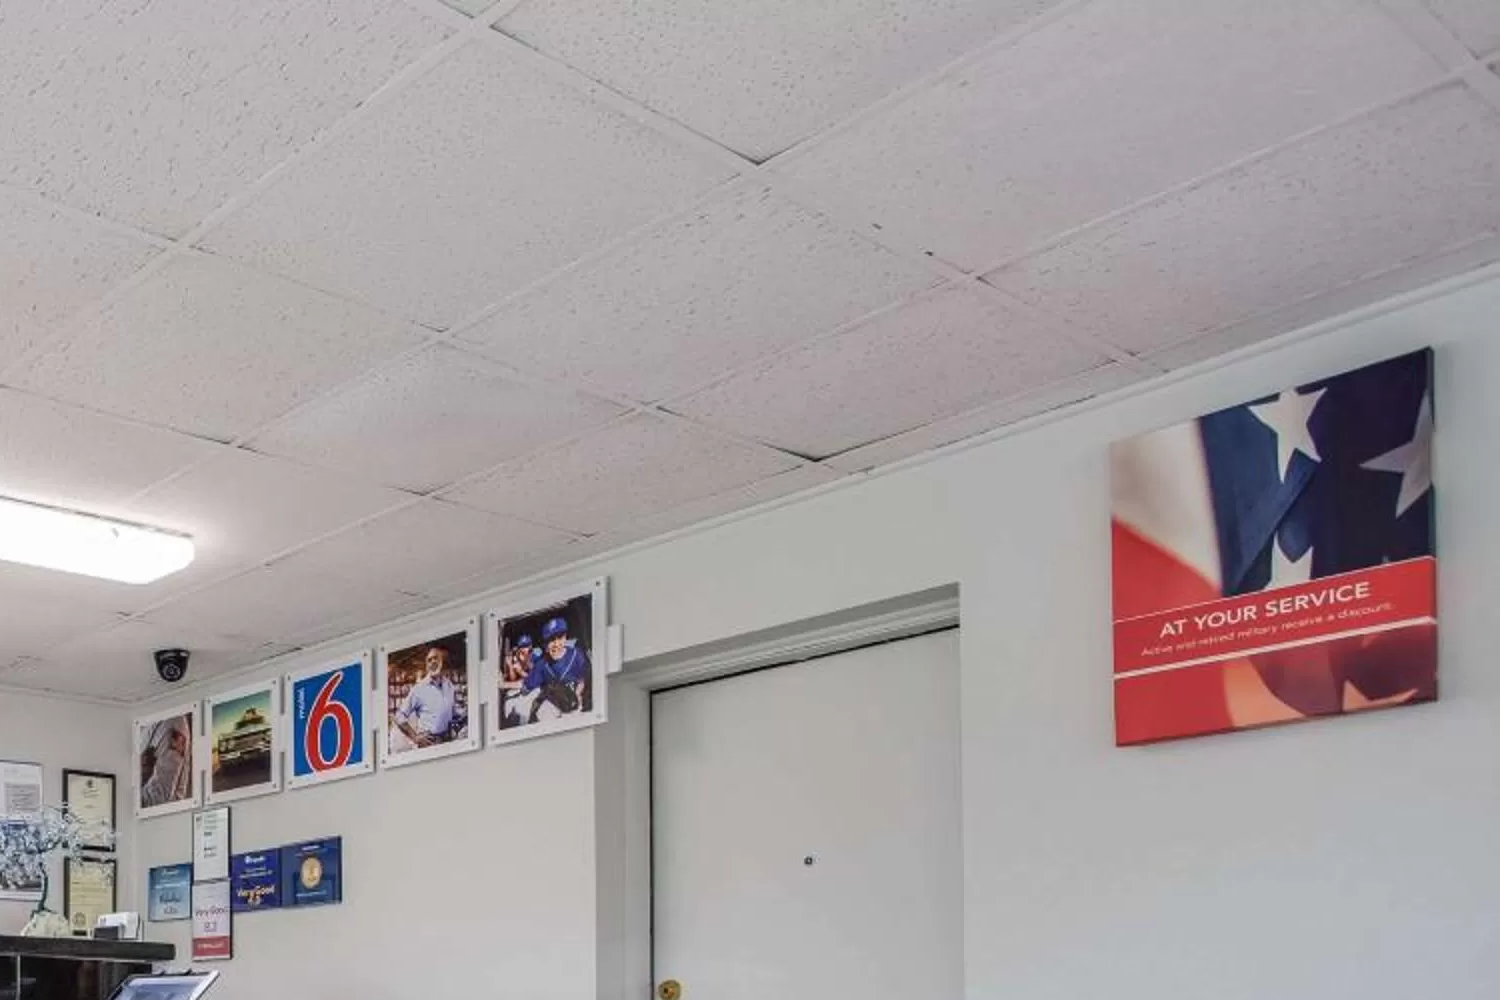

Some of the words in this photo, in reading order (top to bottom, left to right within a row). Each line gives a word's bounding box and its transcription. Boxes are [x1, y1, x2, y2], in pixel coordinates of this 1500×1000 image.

[1141, 644, 1173, 656] Active
[1282, 615, 1323, 631] receive
[1160, 618, 1188, 638] AT
[1193, 605, 1257, 631] YOUR
[1264, 581, 1371, 617] SERVICE
[304, 671, 355, 780] 6
